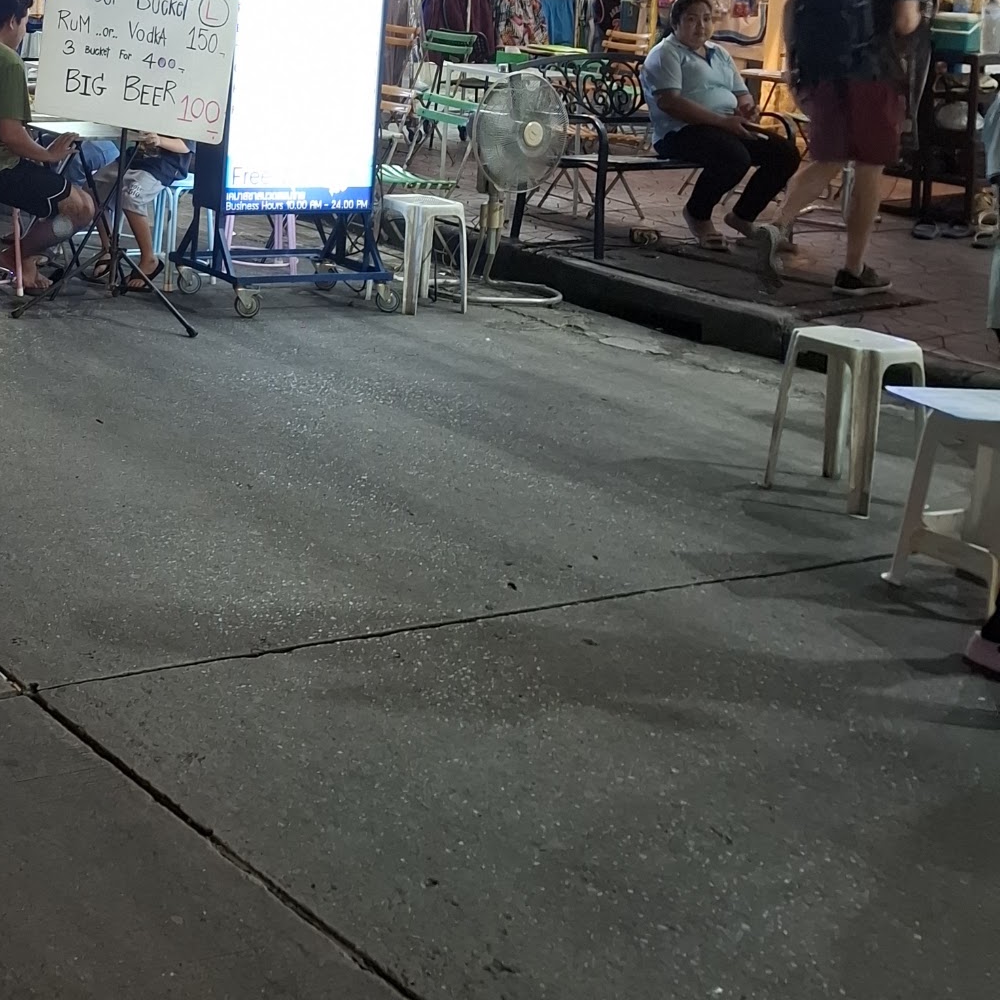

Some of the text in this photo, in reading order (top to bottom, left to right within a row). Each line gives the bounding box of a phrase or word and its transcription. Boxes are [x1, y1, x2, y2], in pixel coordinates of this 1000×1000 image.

[62, 40, 76, 55] 3
[65, 68, 177, 107] BIG BEER
[226, 201, 259, 210] Business
[262, 201, 283, 210] Hours
[310, 200, 322, 209] AM
[331, 200, 354, 209] 24.00
[356, 200, 368, 209] PM
